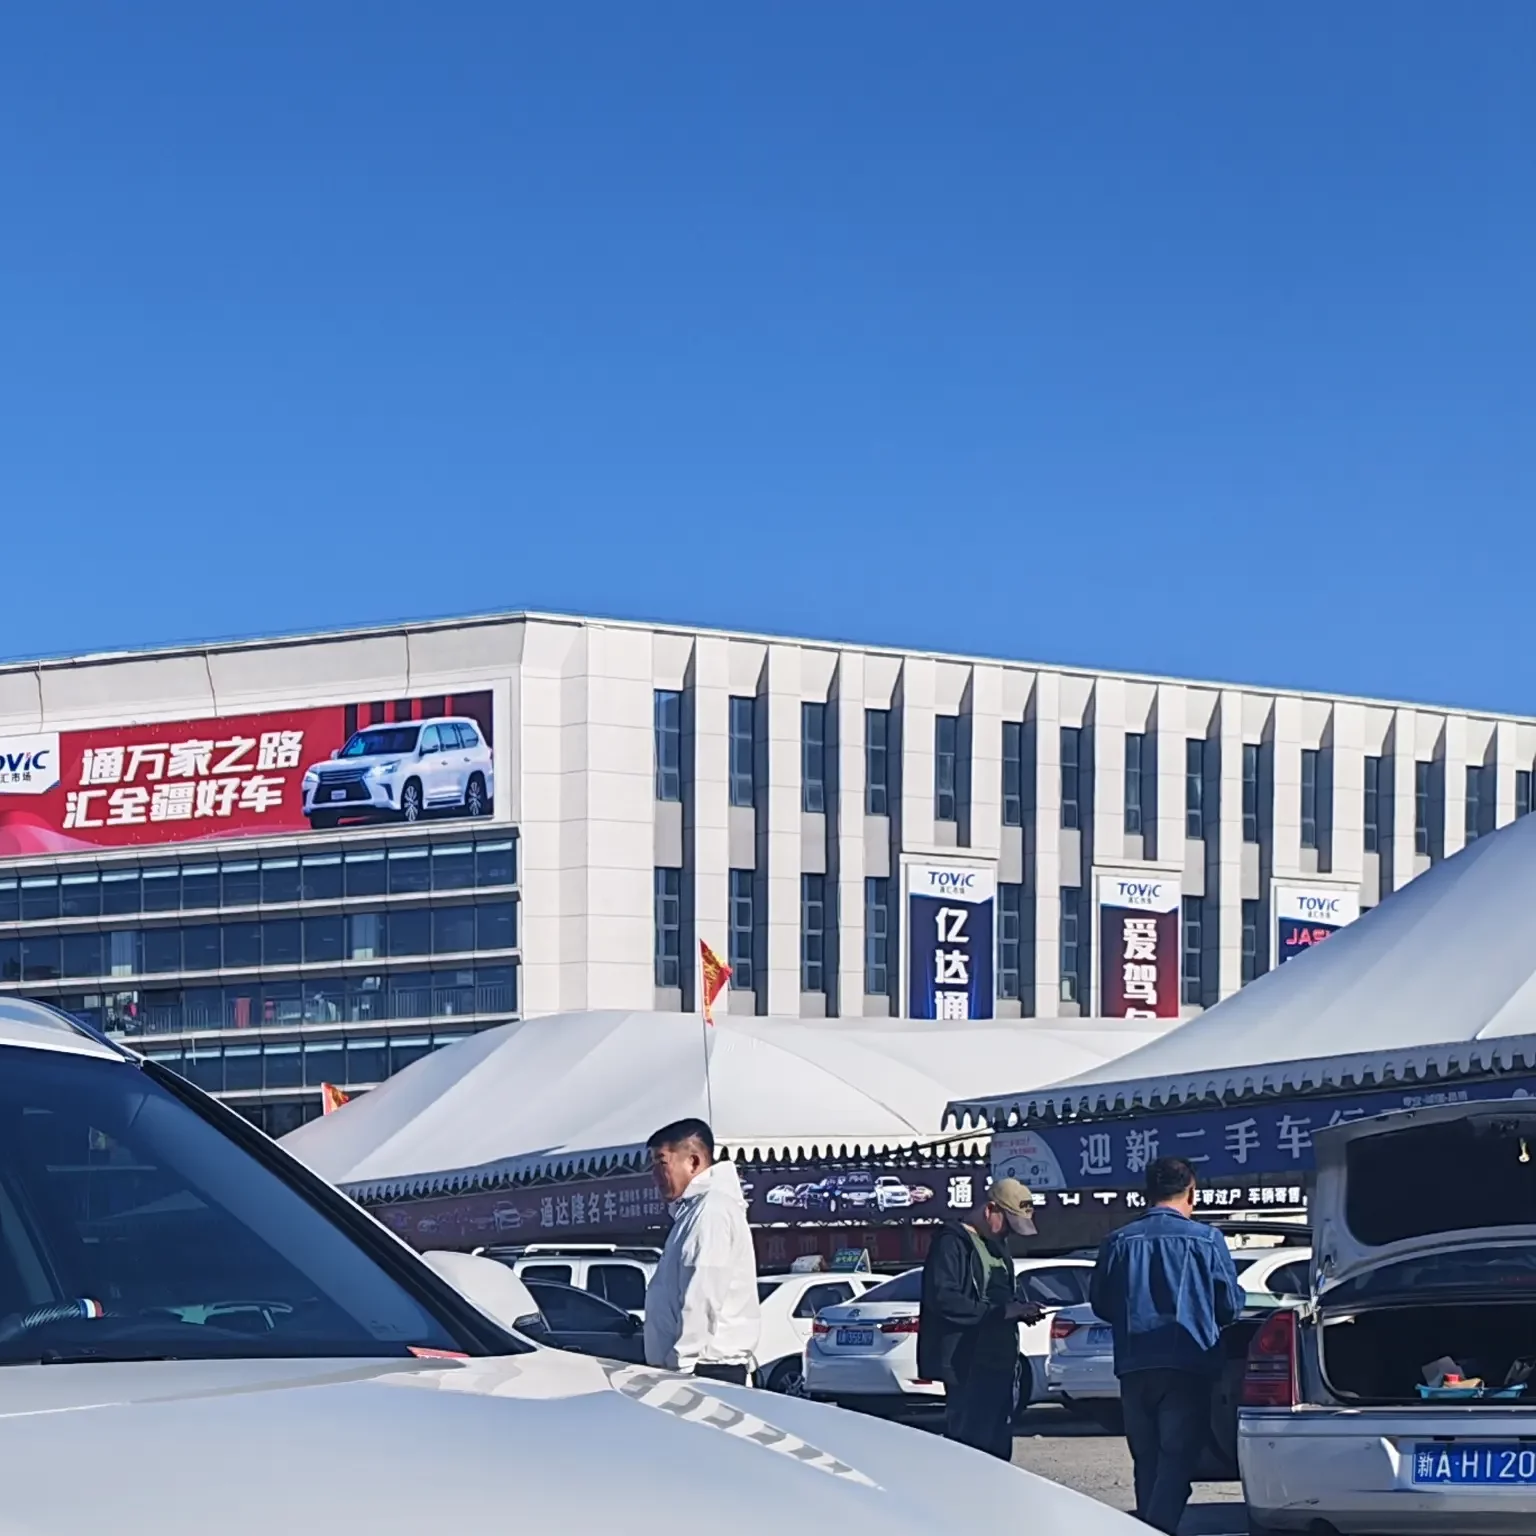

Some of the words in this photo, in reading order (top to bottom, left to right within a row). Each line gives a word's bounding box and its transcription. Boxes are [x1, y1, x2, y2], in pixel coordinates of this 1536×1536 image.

[79, 731, 304, 785] 通万家之路
[63, 776, 286, 829] 汇全疆好车
[935, 907, 970, 1020] 亿达通
